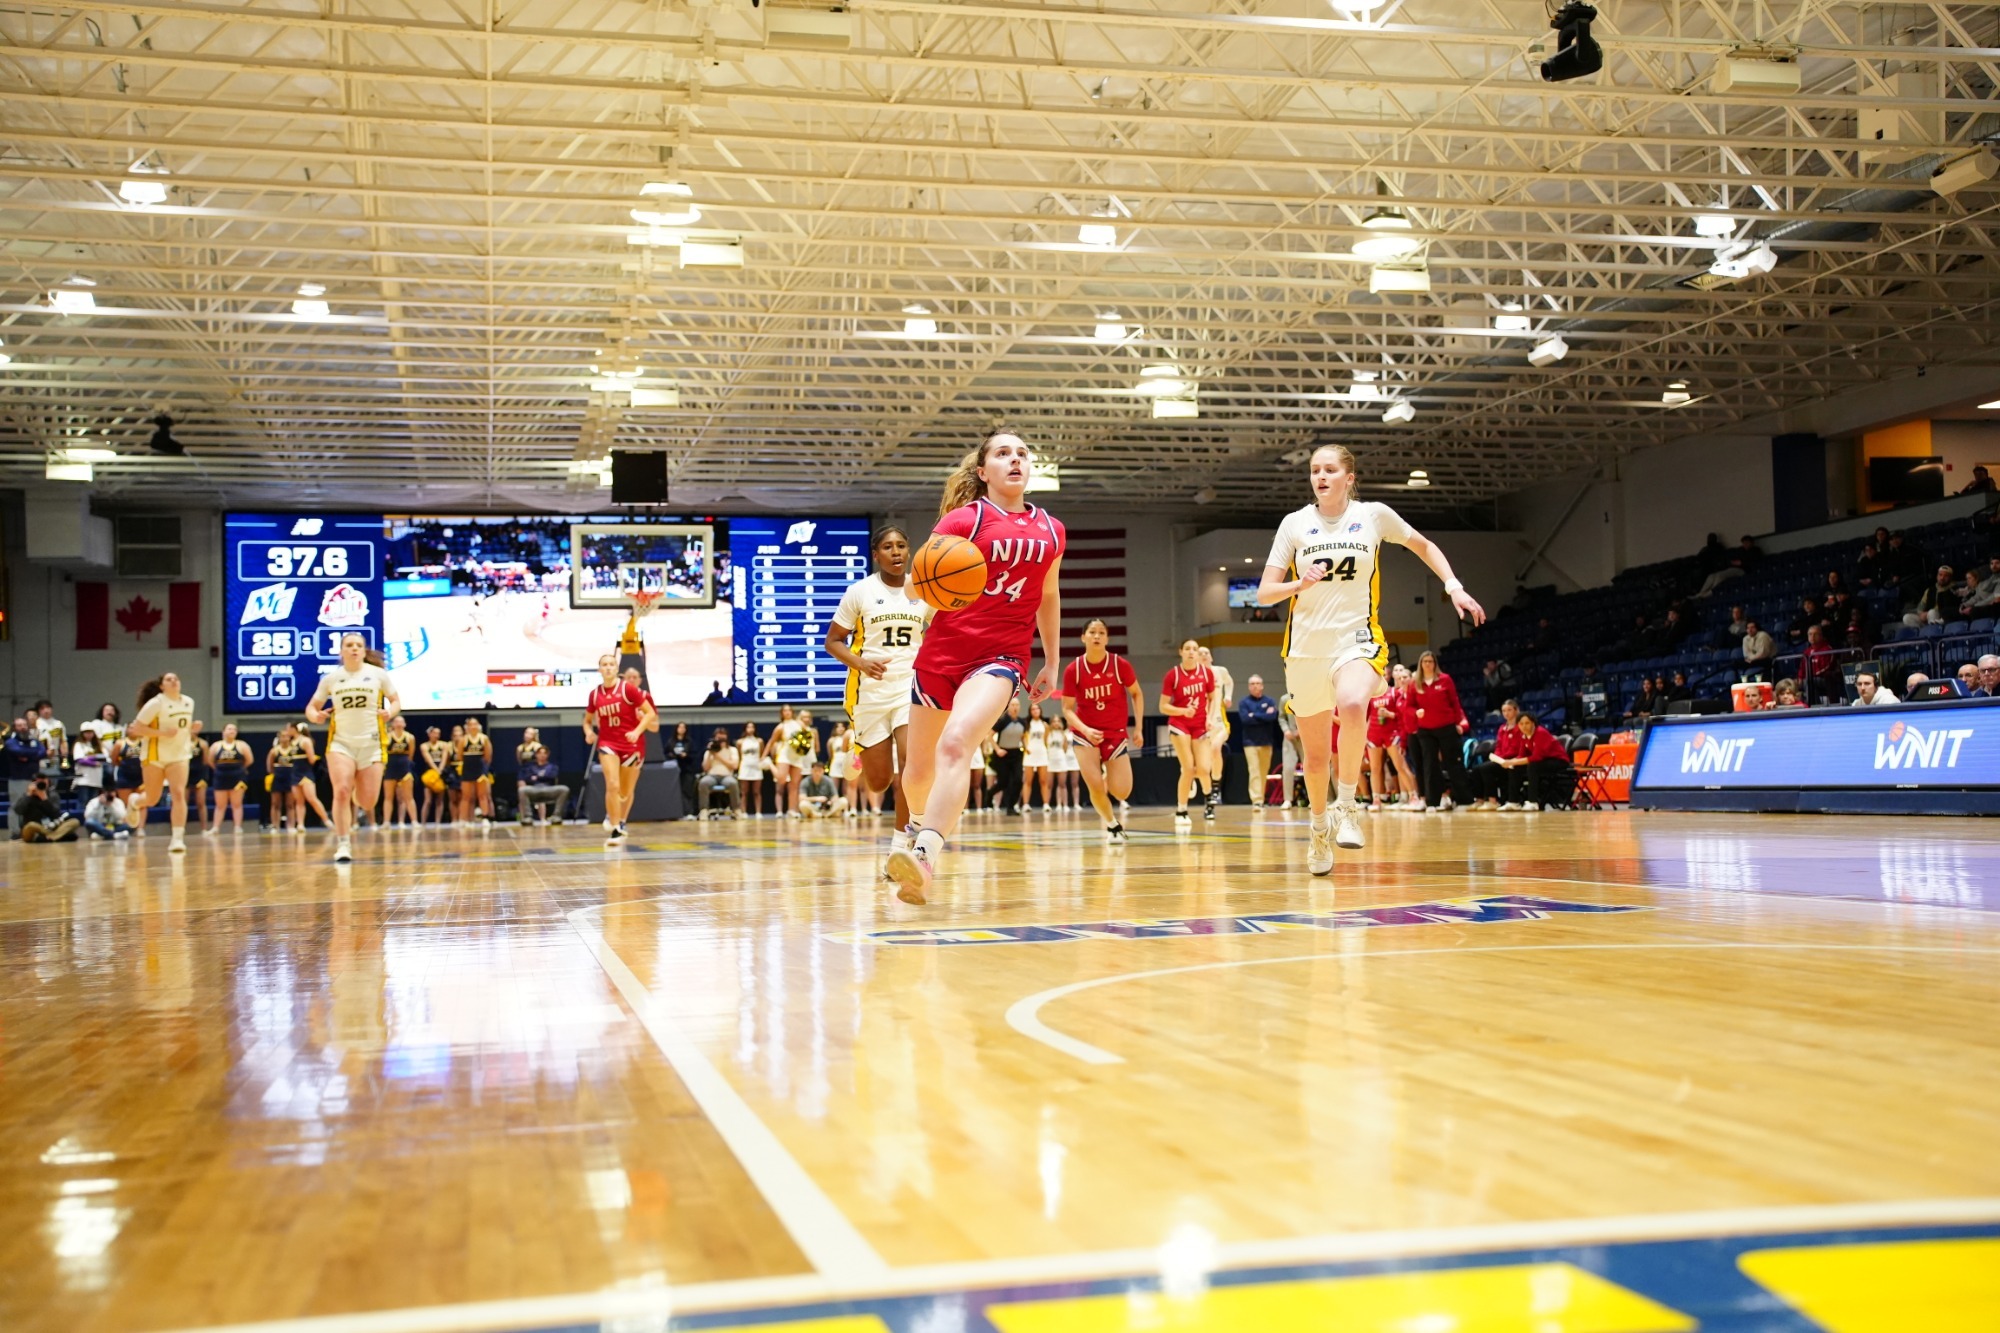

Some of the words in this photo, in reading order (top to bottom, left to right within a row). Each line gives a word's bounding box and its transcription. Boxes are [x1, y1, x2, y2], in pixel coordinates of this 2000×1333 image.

[990, 538, 1048, 569] NJIT
[1302, 542, 1369, 557] MERRIMACK
[267, 547, 348, 576] 37.6
[1313, 556, 1357, 581] 24
[984, 570, 1028, 603] 34
[251, 632, 292, 655] 25
[302, 637, 312, 651] 1
[882, 626, 913, 647] 15
[245, 681, 259, 696] 3
[275, 681, 289, 696] 4
[1084, 683, 1113, 701] NJIT
[1182, 682, 1204, 696] NJIT
[341, 695, 367, 709] 22
[599, 702, 621, 717] NJIT
[608, 716, 621, 727] 10
[1680, 734, 1755, 773] WNIT
[1874, 725, 1974, 770] WNIT
